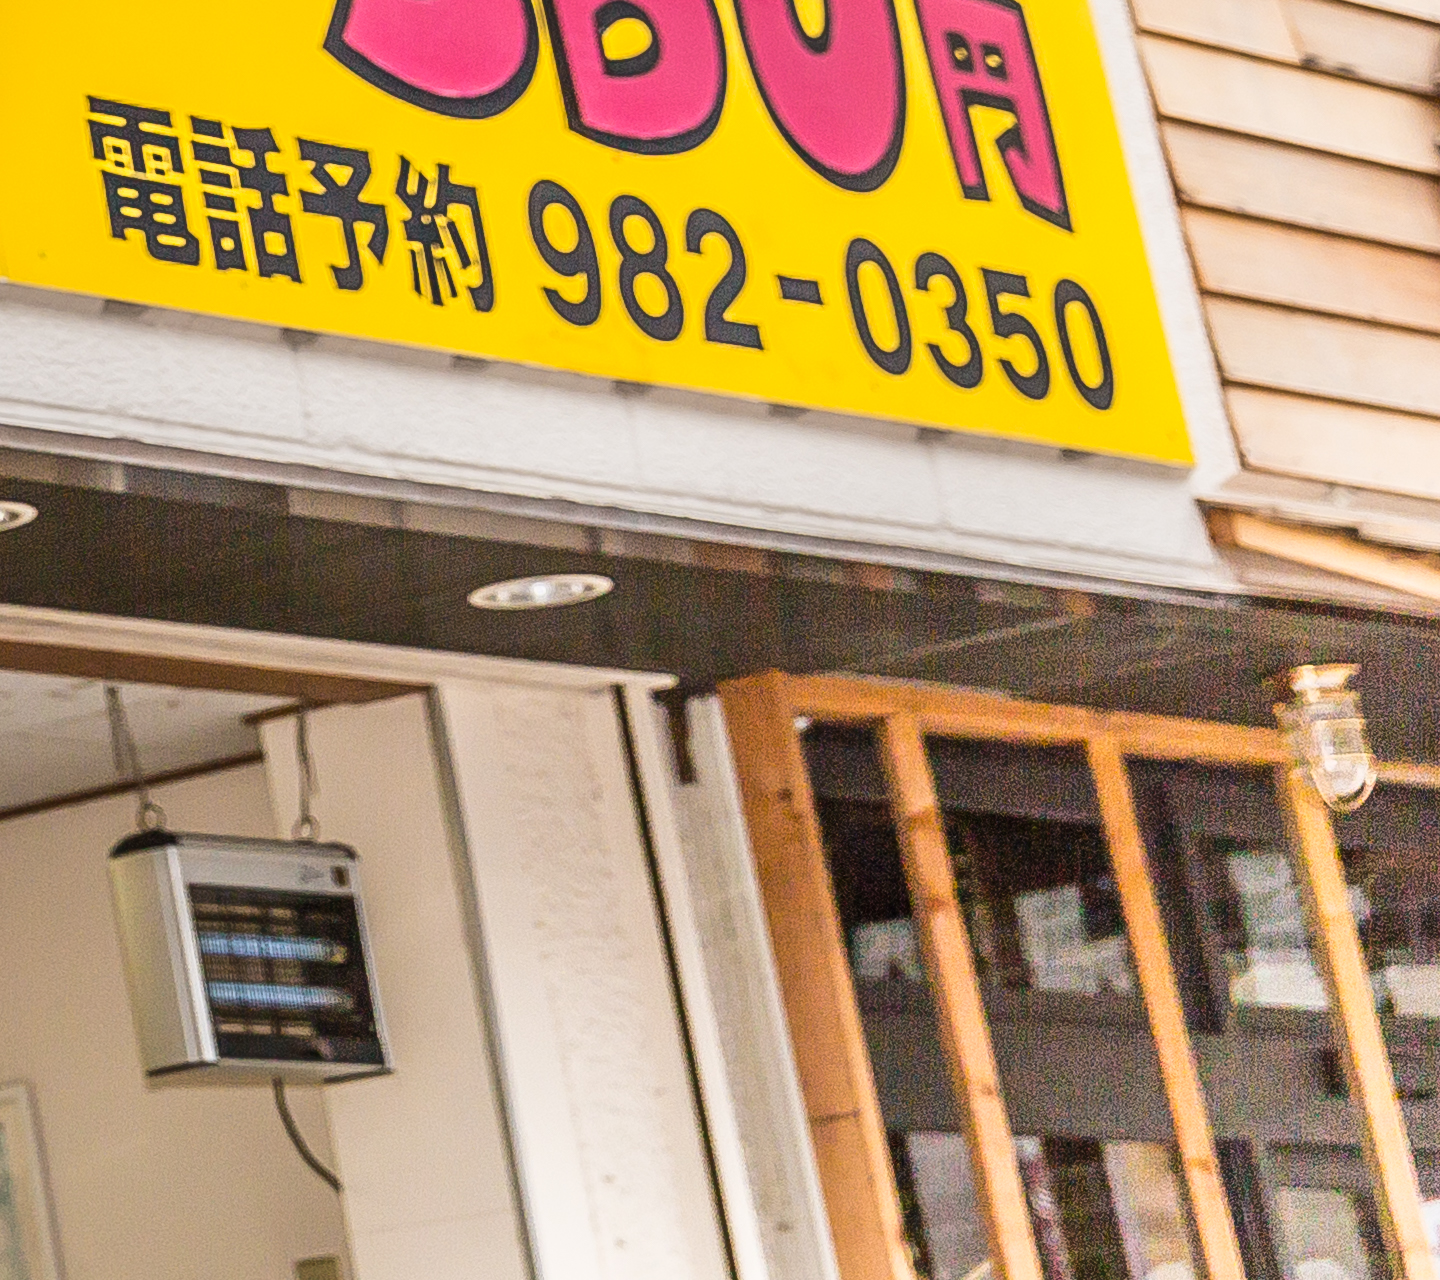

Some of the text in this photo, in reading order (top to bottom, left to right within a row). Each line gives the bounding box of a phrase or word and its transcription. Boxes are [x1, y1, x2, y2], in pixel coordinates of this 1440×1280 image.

[86, 95, 1117, 413] 電話予約 982-0350
